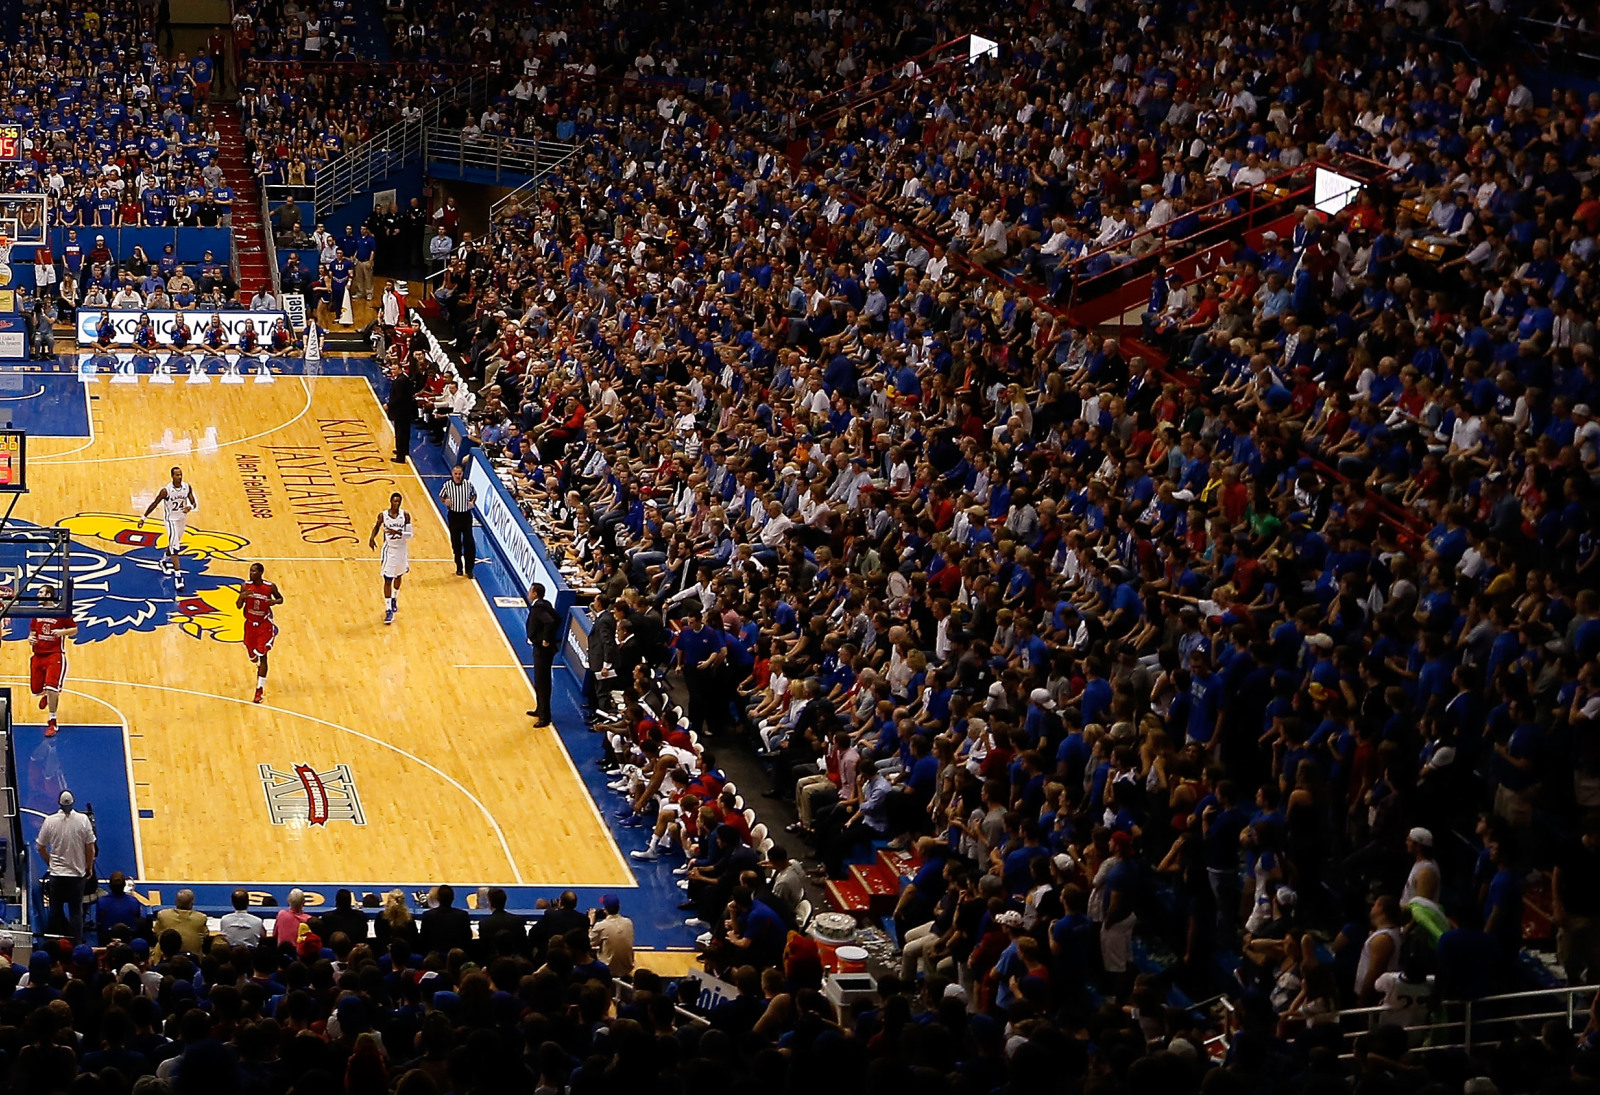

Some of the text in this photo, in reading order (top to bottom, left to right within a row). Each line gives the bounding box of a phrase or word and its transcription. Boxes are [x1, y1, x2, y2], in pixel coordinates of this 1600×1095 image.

[235, 453, 273, 519] Allen Fieldhouse
[317, 419, 396, 487] KANSAS
[172, 500, 185, 512] 24
[258, 444, 360, 545] JAYHAWKS
[489, 495, 538, 582] KONICA MINOLTA
